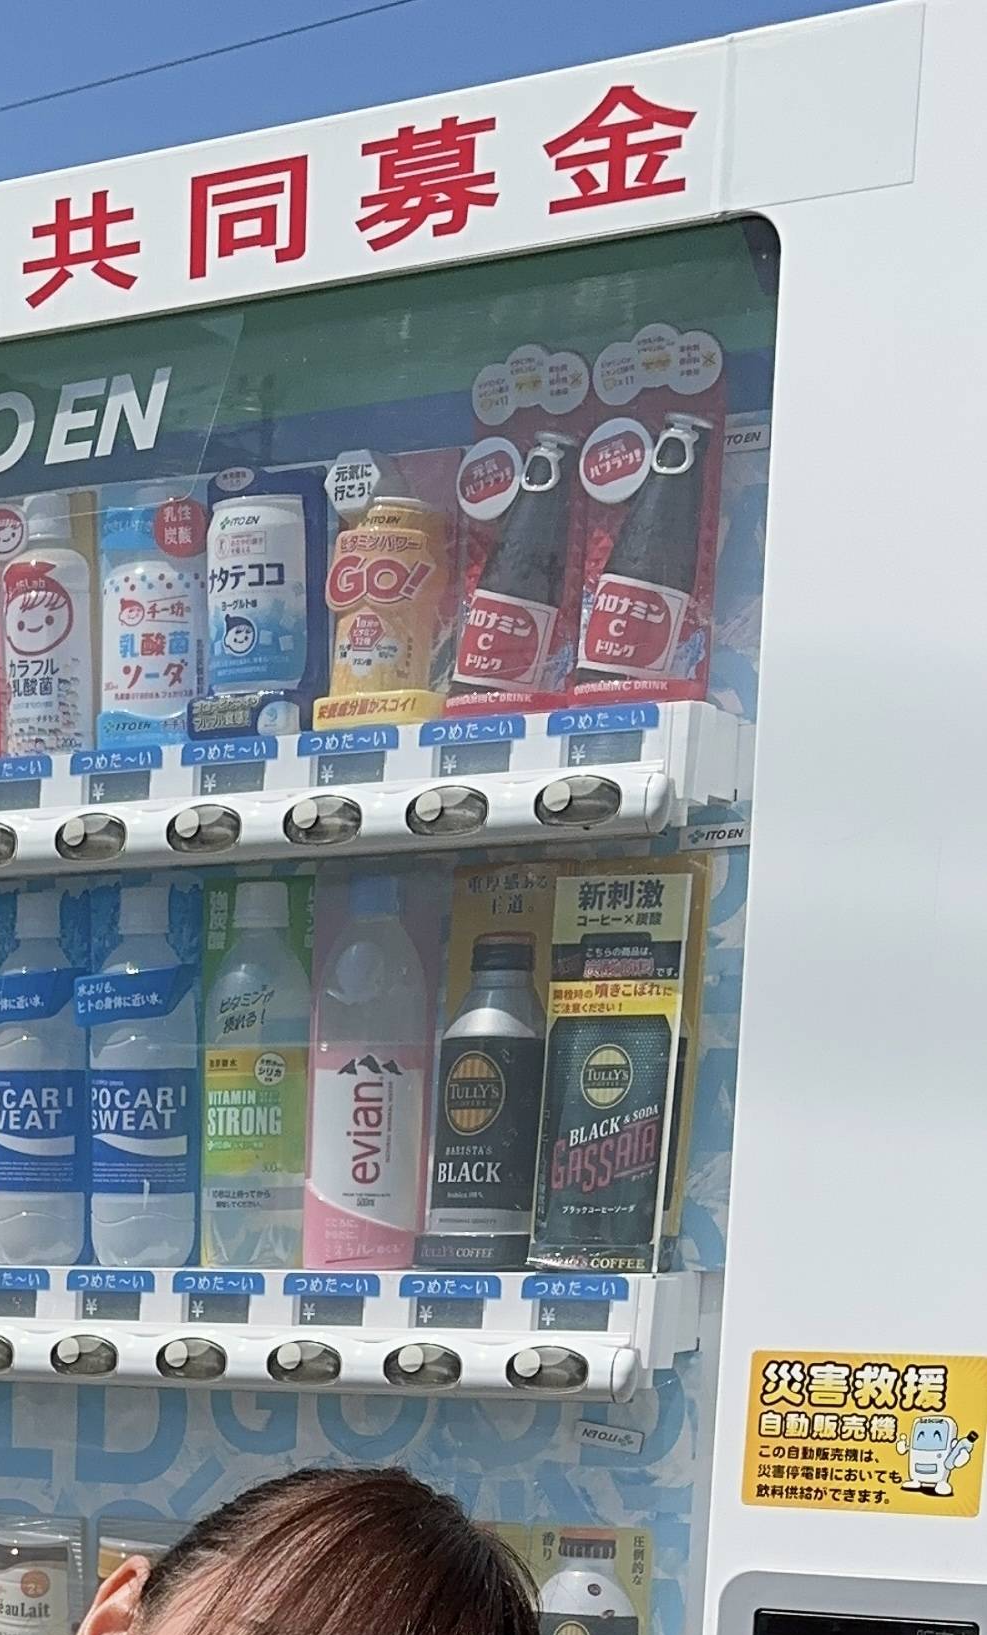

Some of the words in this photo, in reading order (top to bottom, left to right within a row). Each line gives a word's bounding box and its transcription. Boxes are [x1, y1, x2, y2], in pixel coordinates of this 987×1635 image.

[335, 465, 372, 482] 元気に
[334, 484, 373, 501] 行こう!
[163, 506, 192, 523] 乳性
[164, 526, 192, 545] 炭酸
[327, 554, 431, 609] GO!
[595, 591, 667, 624] オロナミン
[467, 607, 533, 637] オロナミン
[608, 619, 627, 636] C
[119, 630, 191, 659] 乳酸菌
[477, 633, 494, 650] C
[595, 640, 635, 658] ドリンク
[9, 659, 60, 677] カラフル
[465, 653, 502, 671] ドリンク
[121, 658, 188, 690] ソーダ
[10, 677, 53, 697] 乳酸菌
[634, 680, 668, 691] DRINK
[469, 873, 549, 893] 重厚感ある
[578, 879, 665, 911] 新刺激
[576, 912, 662, 927] コーヒー×炭酸
[586, 946, 653, 957] こちらの商品は、
[77, 982, 116, 998] 水よりも、
[208, 1090, 256, 1105] VITAMIN
[207, 1106, 282, 1136] STRONG
[569, 1115, 622, 1148] BLACK
[623, 1114, 632, 1124] &
[632, 1104, 660, 1122] SODA
[347, 1081, 384, 1185] evian
[550, 1120, 658, 1193] GASSATA
[437, 1161, 503, 1183] BLACK
[561, 1204, 636, 1216] ブラックコーヒーソーダ
[456, 1247, 495, 1258] COFFEE
[590, 1256, 645, 1269] COFFEE
[760, 1360, 948, 1411] 災害救援
[759, 1410, 899, 1443] 自動販売機
[758, 1445, 880, 1464] この自動販売機は、
[757, 1464, 903, 1485] 災害停電時においても
[755, 1483, 891, 1505] 飲料供給ができます。
[542, 1530, 555, 1562] 香り
[632, 1535, 646, 1586] 圧倒的な
[5, 1604, 19, 1617] au
[19, 1601, 51, 1618] Lait
